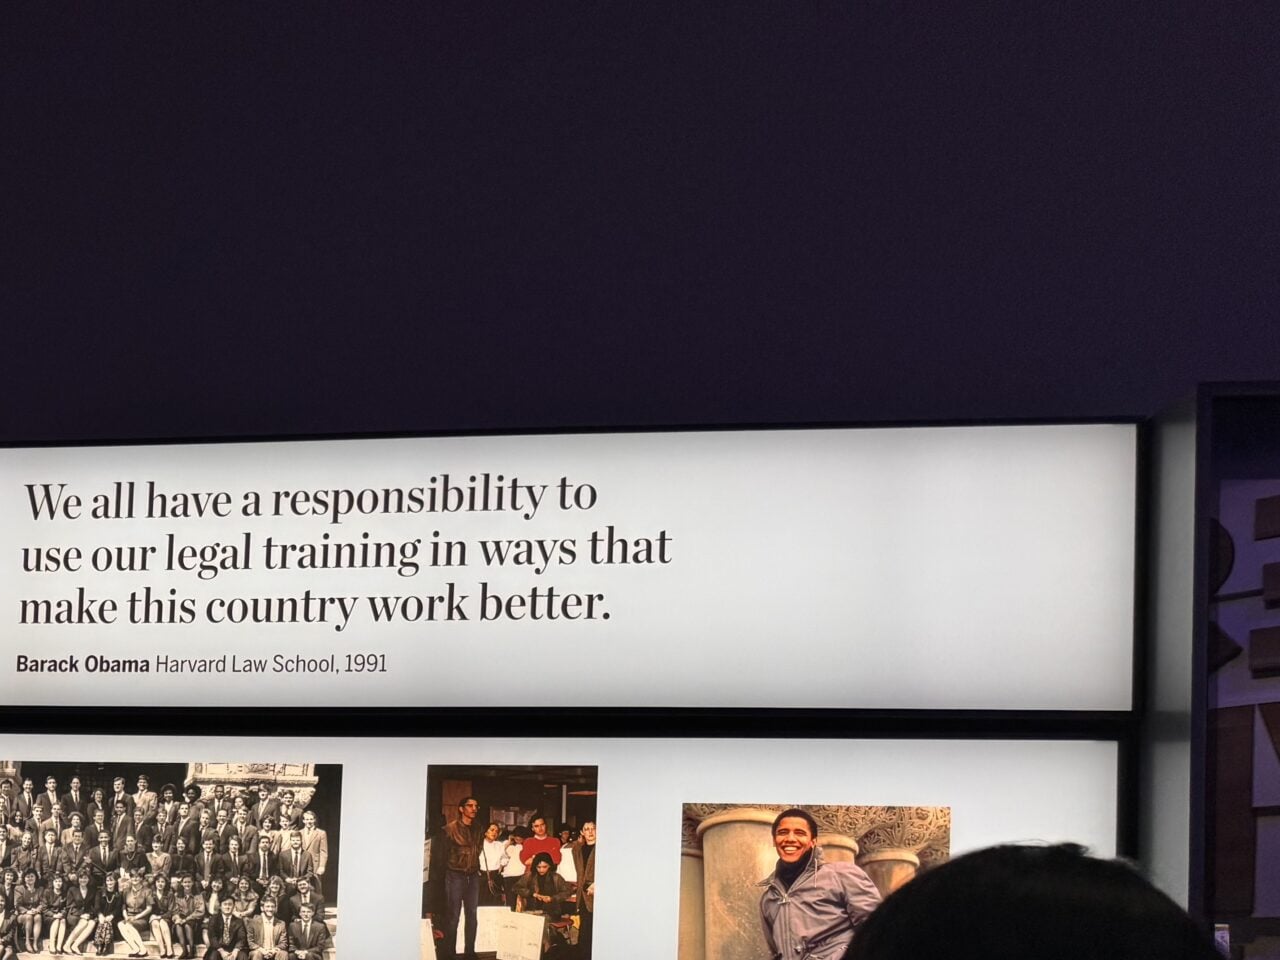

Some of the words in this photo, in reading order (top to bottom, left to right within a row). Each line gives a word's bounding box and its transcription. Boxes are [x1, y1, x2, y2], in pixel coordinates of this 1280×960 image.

[26, 483, 82, 520] We
[91, 481, 135, 519] all
[146, 481, 232, 518] have
[241, 491, 262, 516] a
[272, 472, 548, 524] responsibility
[556, 476, 597, 510] to
[22, 547, 82, 572] use
[91, 546, 156, 572] our
[166, 532, 251, 580] legal
[262, 532, 421, 577] training
[430, 530, 466, 566] in
[478, 539, 576, 575] ways
[587, 525, 672, 564] that
[20, 587, 117, 624] make
[127, 586, 195, 624] this
[206, 589, 359, 632] country
[367, 582, 469, 622] work
[479, 582, 610, 621] better.
[16, 654, 79, 672] Barack
[84, 654, 149, 673] Obama
[156, 654, 226, 673] Harvard
[232, 655, 267, 672] Law
[272, 654, 339, 674] School,
[344, 653, 387, 672] 1991
